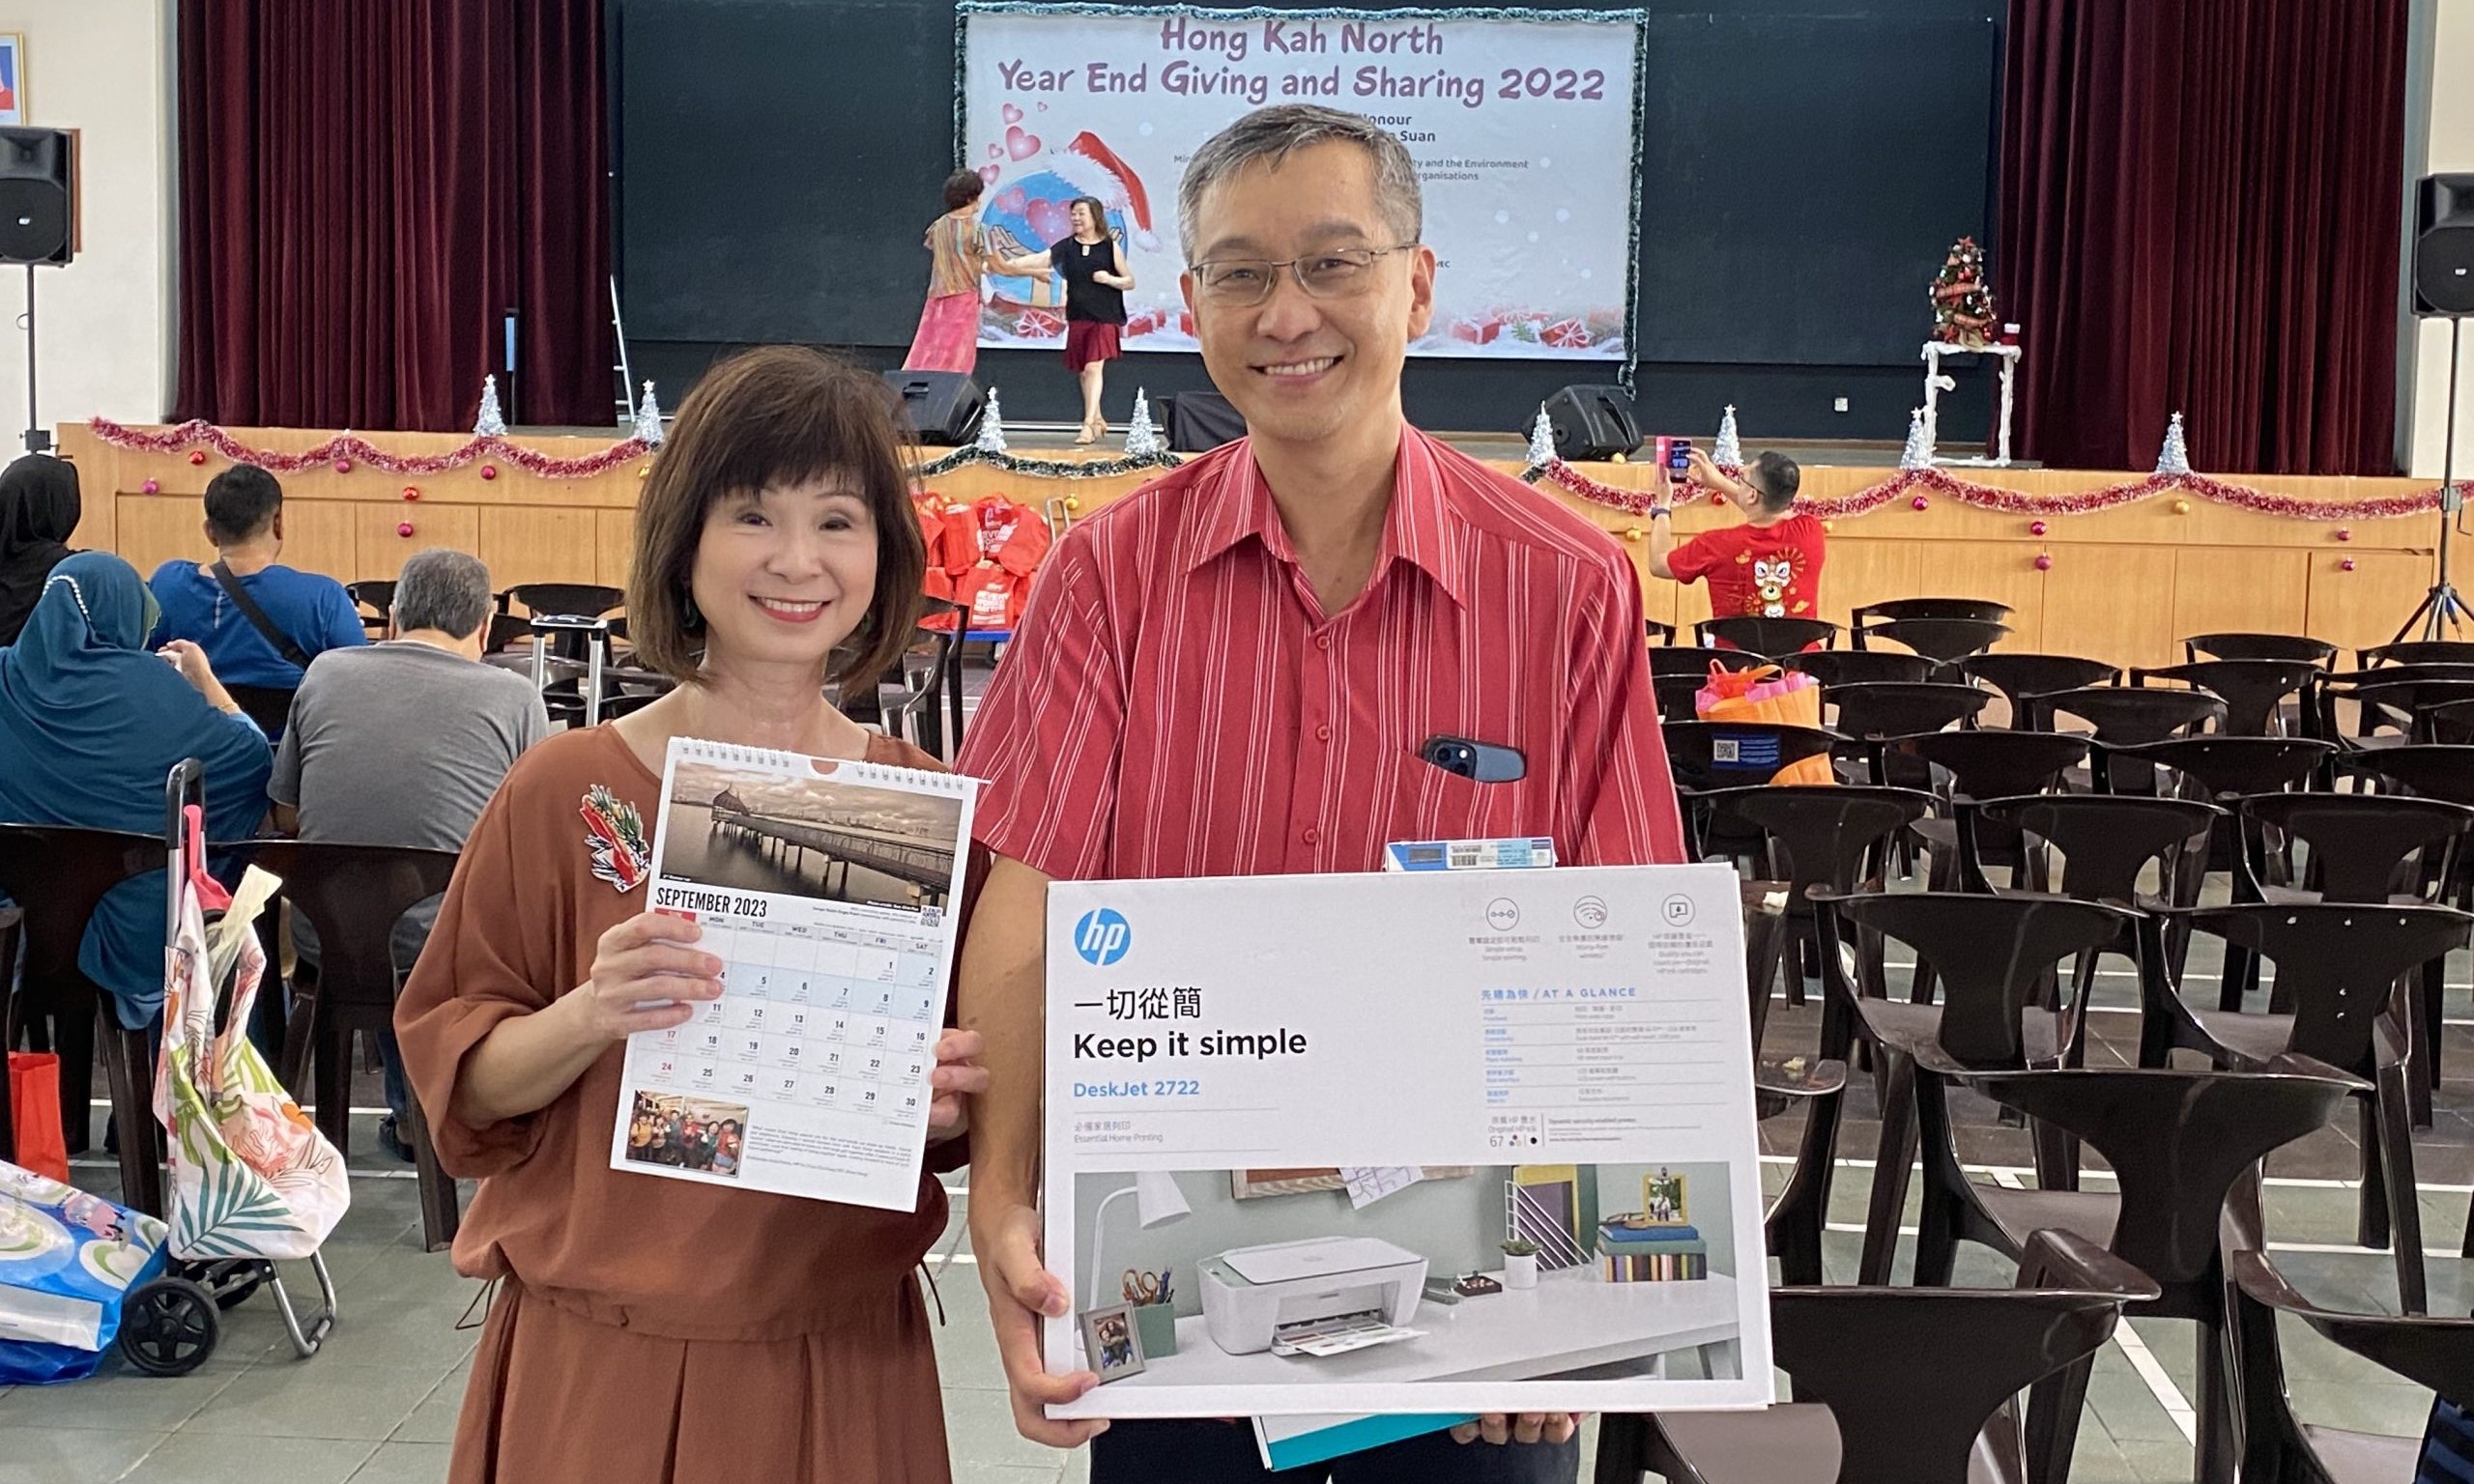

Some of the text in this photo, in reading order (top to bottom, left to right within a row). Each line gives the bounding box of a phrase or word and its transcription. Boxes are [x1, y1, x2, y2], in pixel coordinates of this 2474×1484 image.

[1160, 16, 1443, 62] Hong Kah North
[997, 58, 1605, 108] Year End Giving and Sharing 2022
[1400, 130, 1436, 142] Suan
[1424, 158, 1444, 168] and
[1445, 159, 1463, 168] the
[1464, 159, 1529, 169] Environment
[1418, 172, 1480, 182] rganisations
[656, 886, 768, 918] SEPTEMBER 2023
[834, 930, 848, 939] THU
[1079, 908, 1127, 965] hp
[802, 982, 807, 990] 6
[843, 987, 849, 996] 7
[882, 993, 889, 1002] 8
[1074, 986, 1202, 1020] 一切從簡
[1580, 987, 1637, 998] GLANCE
[712, 1003, 926, 1041] 11 12 13 14 15 16
[667, 1030, 921, 1073] 17 18 19 20 21 22 23
[1074, 1028, 1308, 1063] Keep it simple
[703, 1069, 713, 1077] 25
[743, 1074, 754, 1083] 26
[784, 1079, 794, 1089] 27
[824, 1085, 835, 1095] 28
[865, 1092, 876, 1100] 29
[906, 1098, 916, 1106] 30
[1074, 1080, 1200, 1098] DeskJet 2722
[1074, 1133, 1164, 1143] Essential Home Printing
[1489, 1135, 1504, 1147] 67
